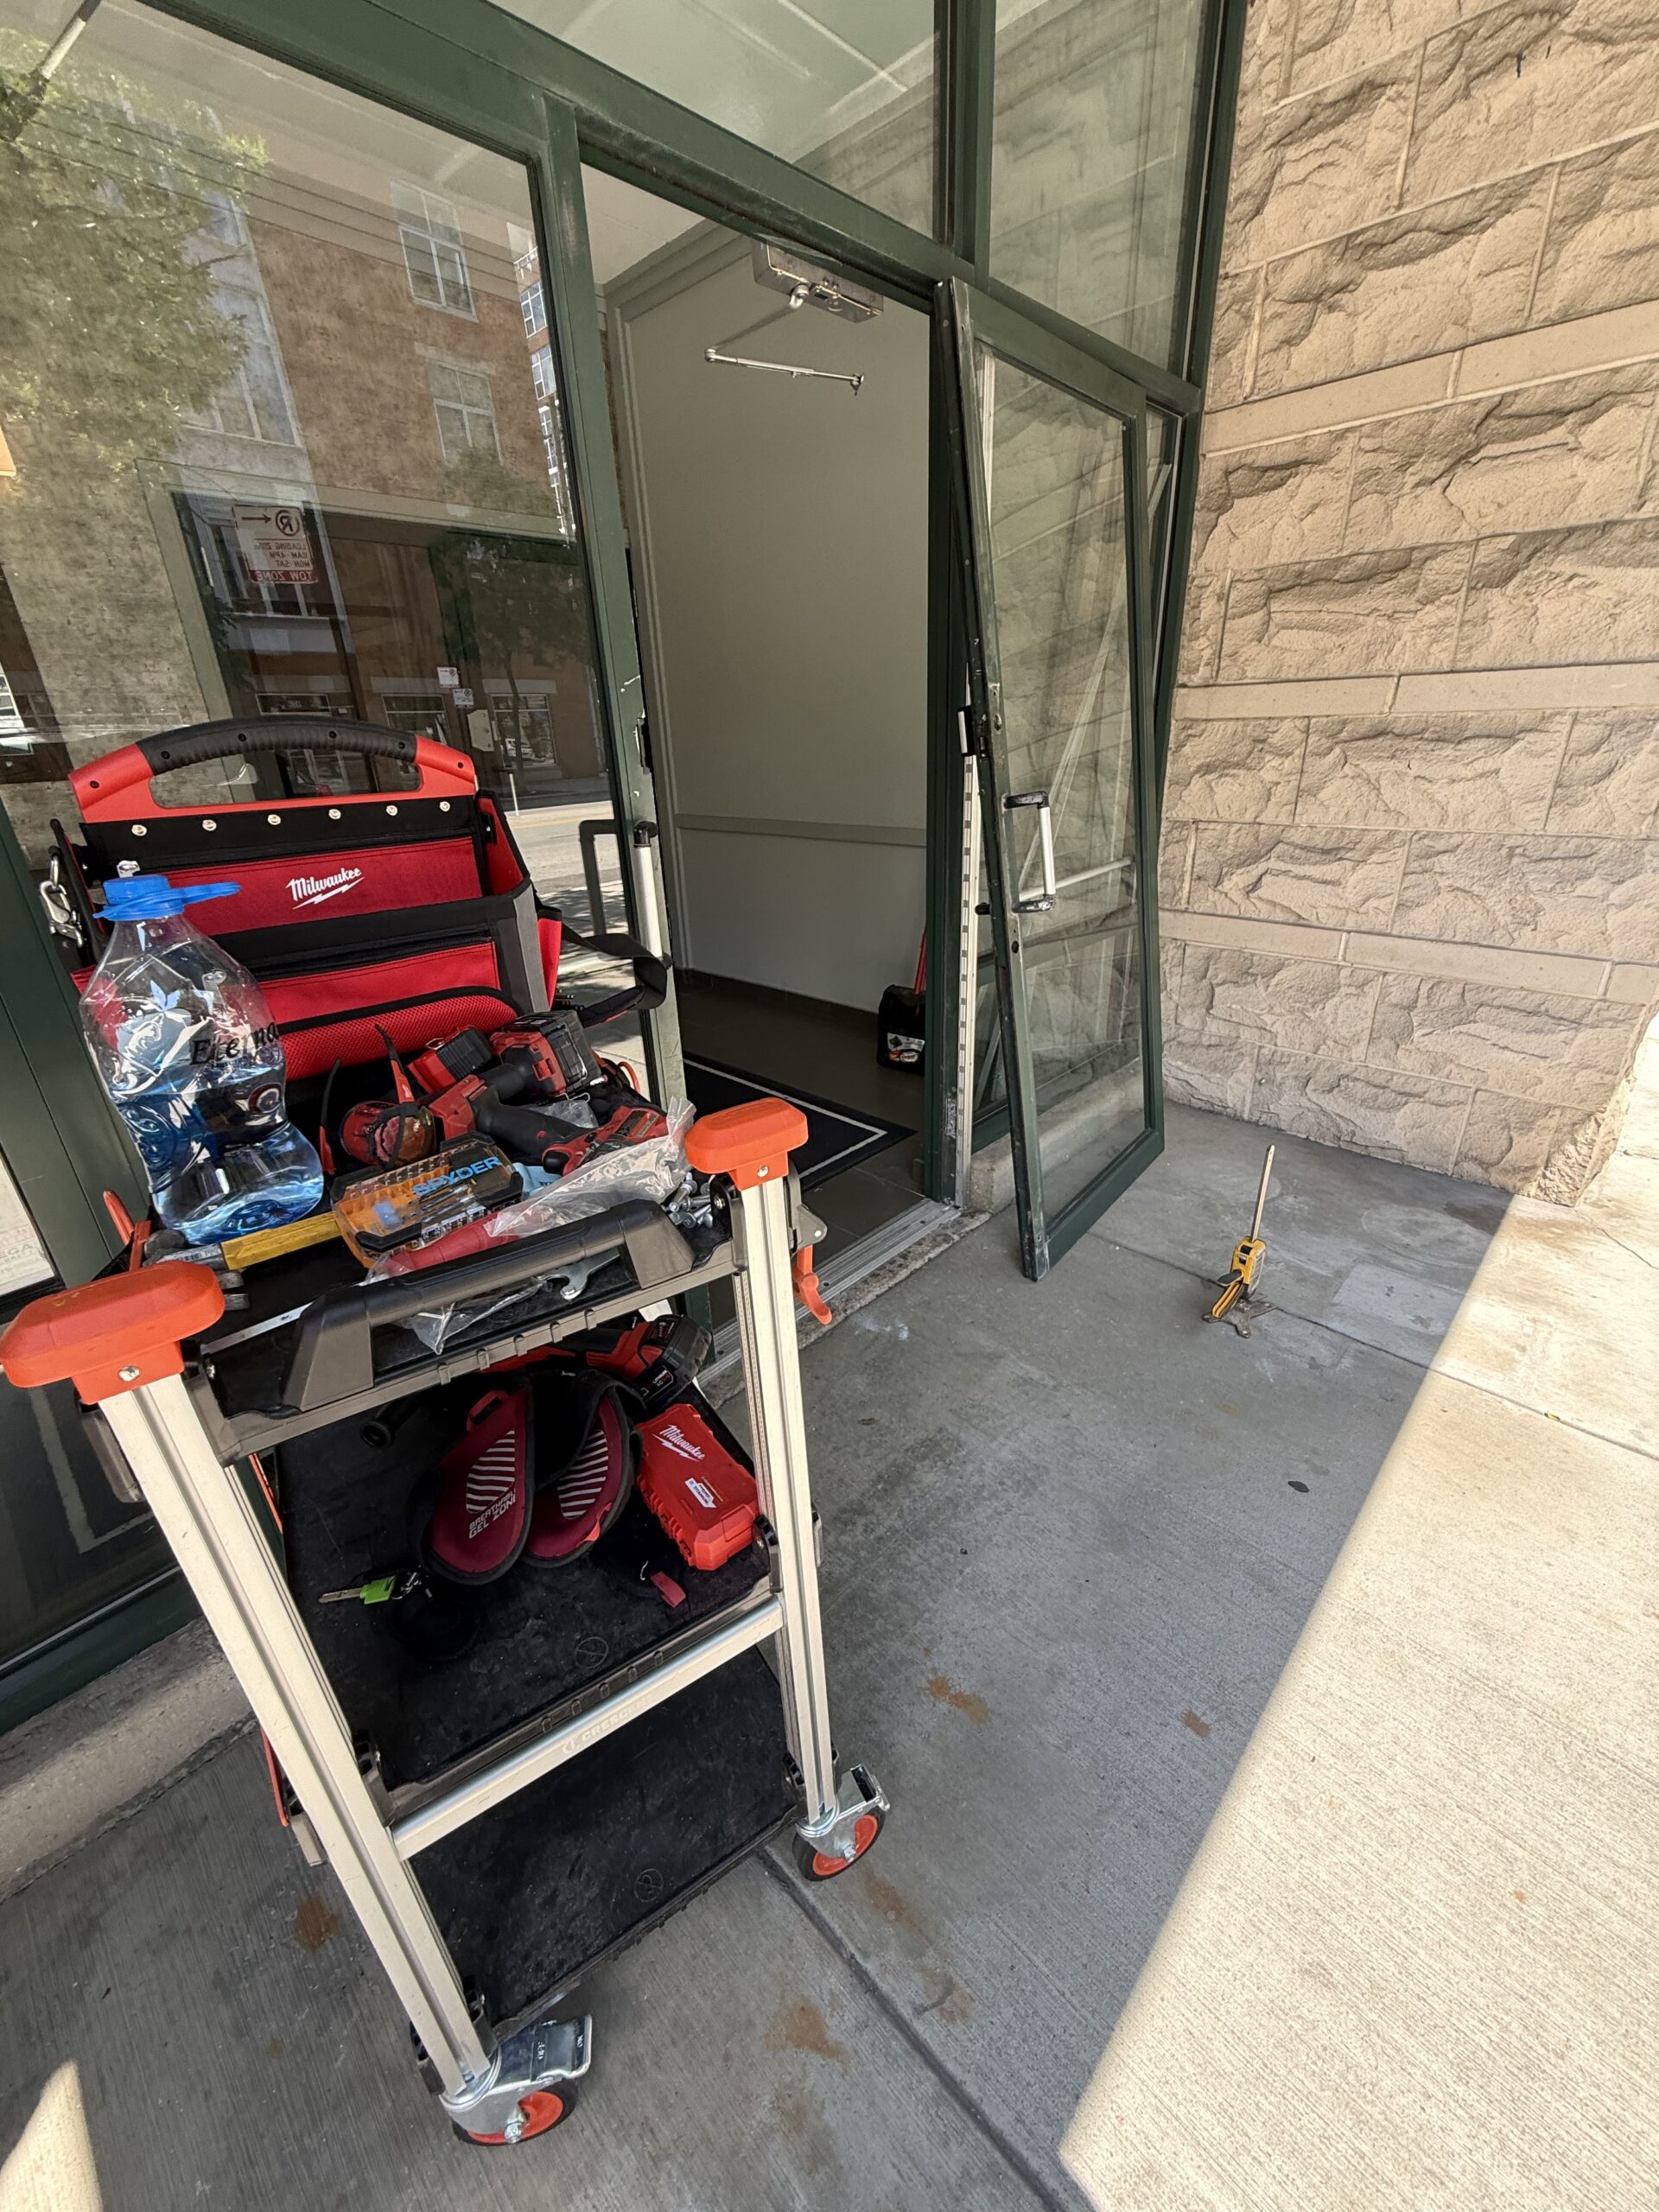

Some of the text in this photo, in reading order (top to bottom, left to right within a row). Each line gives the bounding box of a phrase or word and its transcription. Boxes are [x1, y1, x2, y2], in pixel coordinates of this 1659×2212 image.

[285, 868, 363, 902] Milwaukee
[412, 1156, 501, 1196] SPYDER
[659, 1424, 706, 1460] Milwaukee
[468, 1520, 490, 1539] GEL
[582, 1696, 651, 1742] CRESCEN
